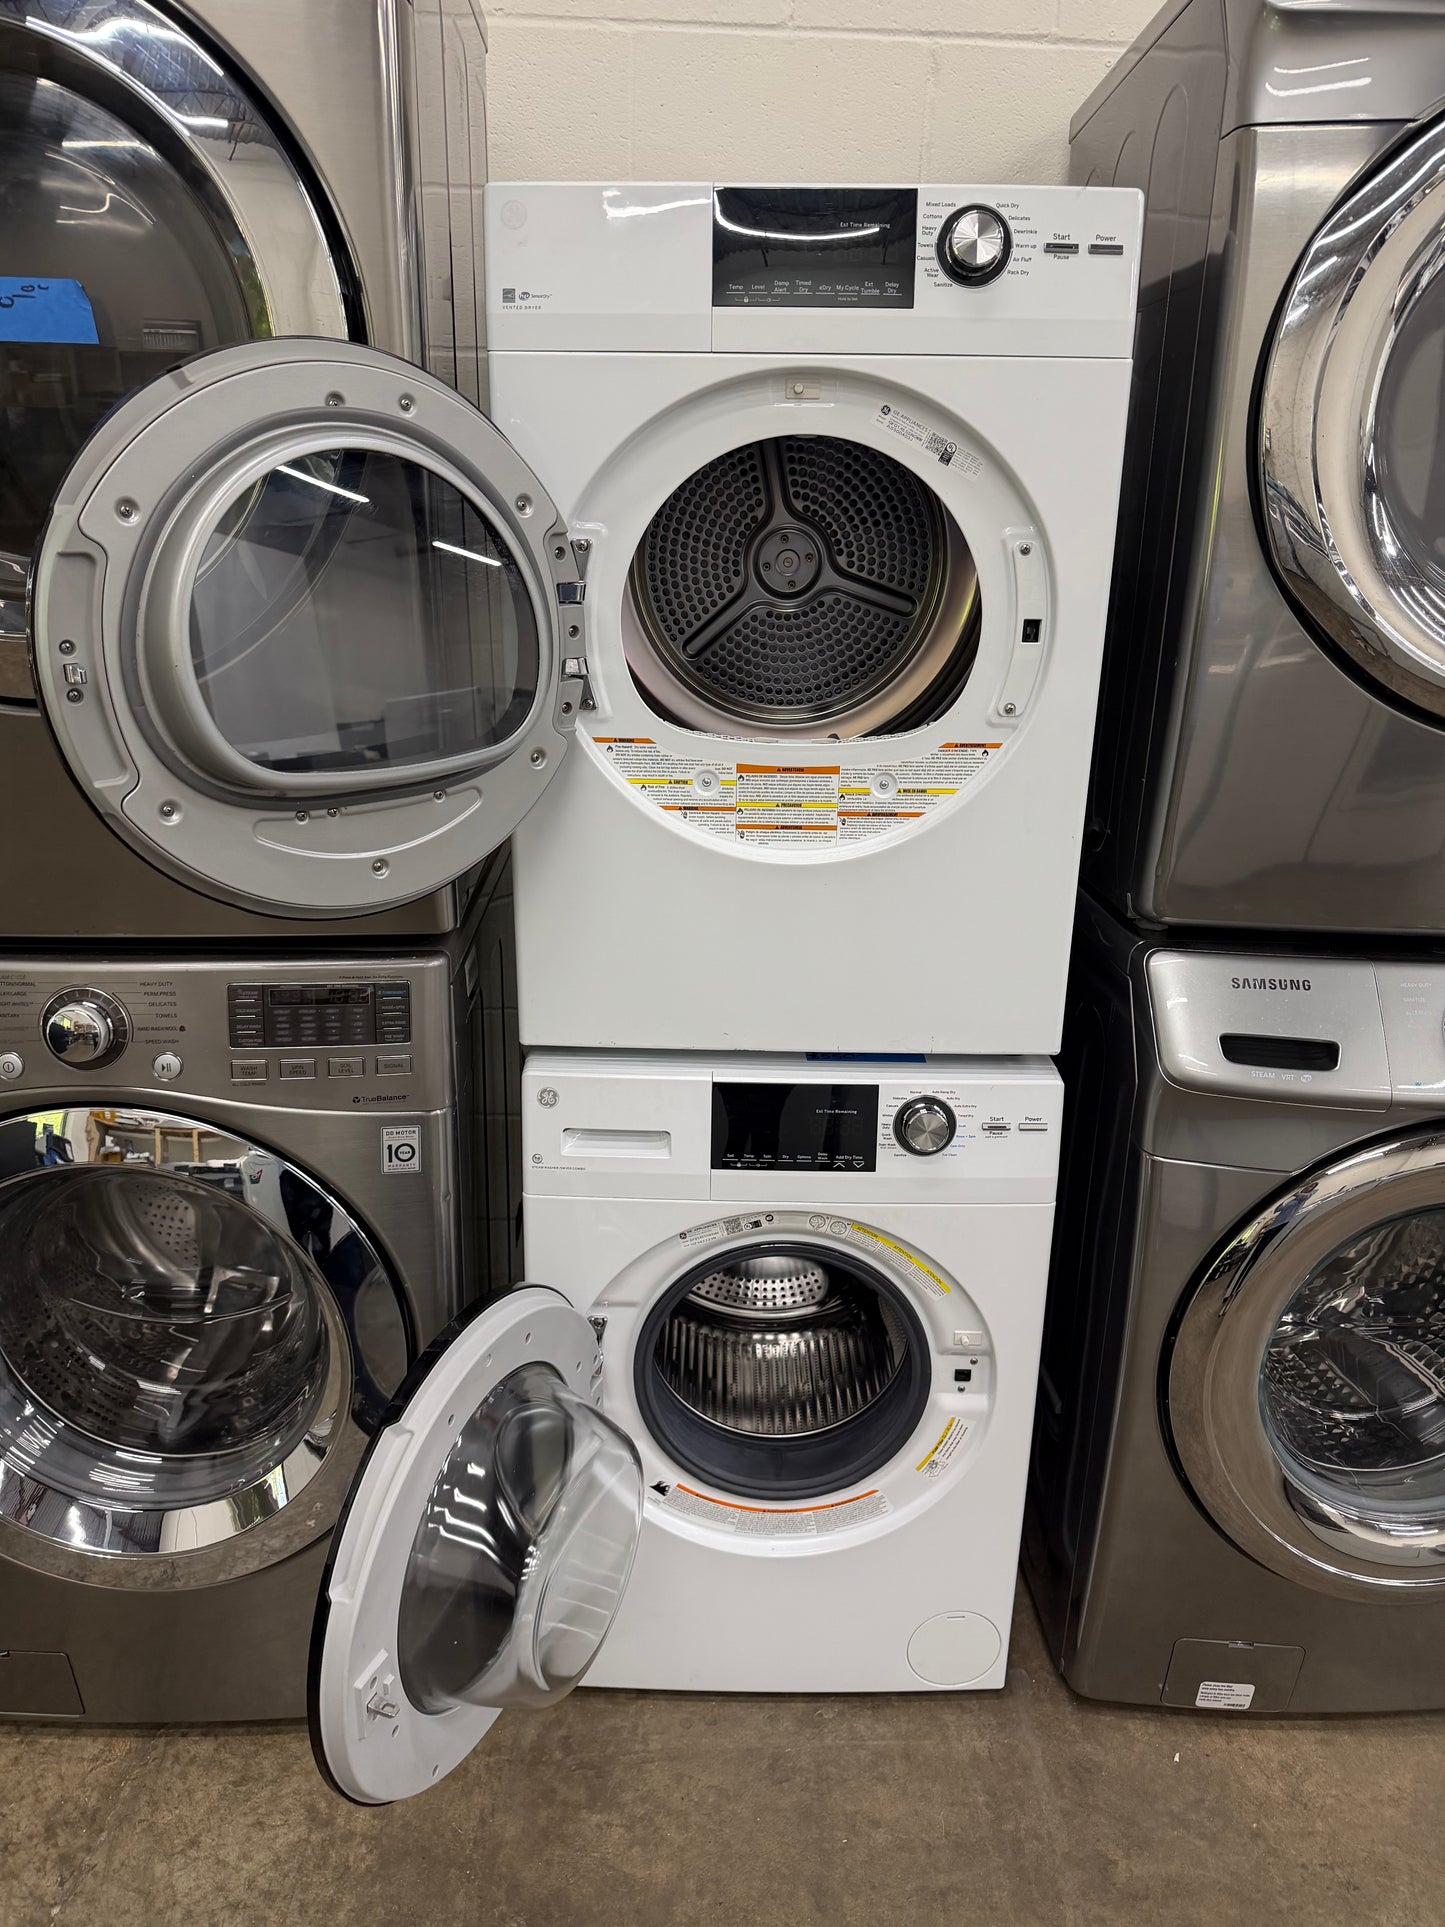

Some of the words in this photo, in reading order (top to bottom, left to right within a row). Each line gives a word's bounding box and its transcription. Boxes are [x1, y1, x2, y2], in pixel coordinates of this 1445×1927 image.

[1231, 978, 1312, 992] SAMSUNG
[1251, 1070, 1276, 1079] STEAM
[1281, 1073, 1294, 1081] VRT
[387, 1143, 416, 1163] 10
